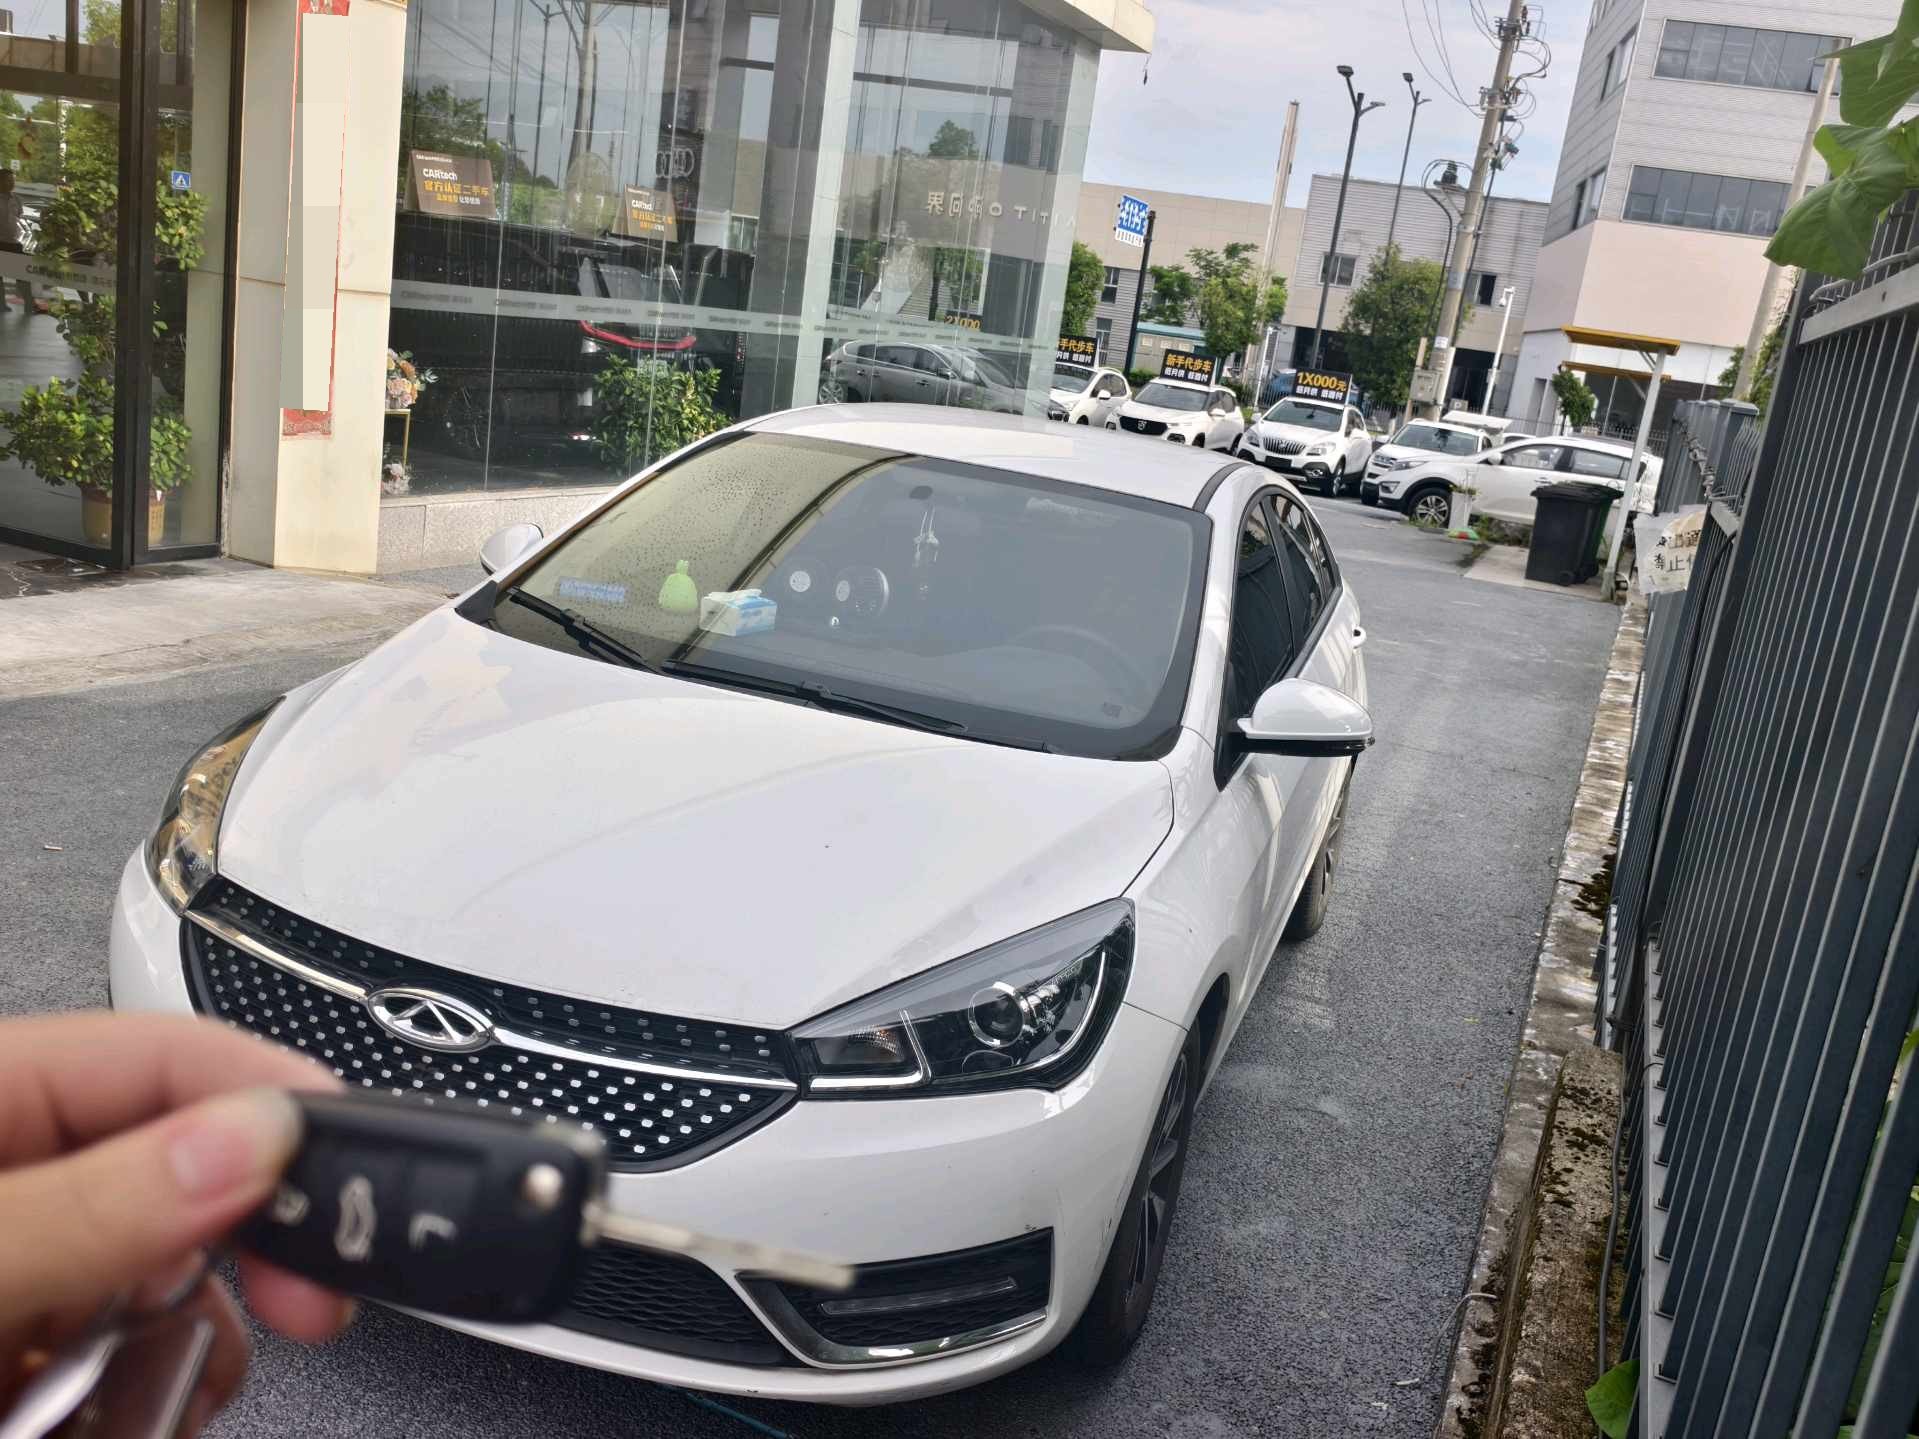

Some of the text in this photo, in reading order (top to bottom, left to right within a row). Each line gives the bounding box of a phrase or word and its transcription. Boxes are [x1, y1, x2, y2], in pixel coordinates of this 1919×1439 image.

[422, 168, 458, 181] CARtech
[1056, 338, 1094, 353] 手代步车
[1166, 353, 1213, 374] 新手代步车
[1297, 371, 1346, 392] 1X000元
